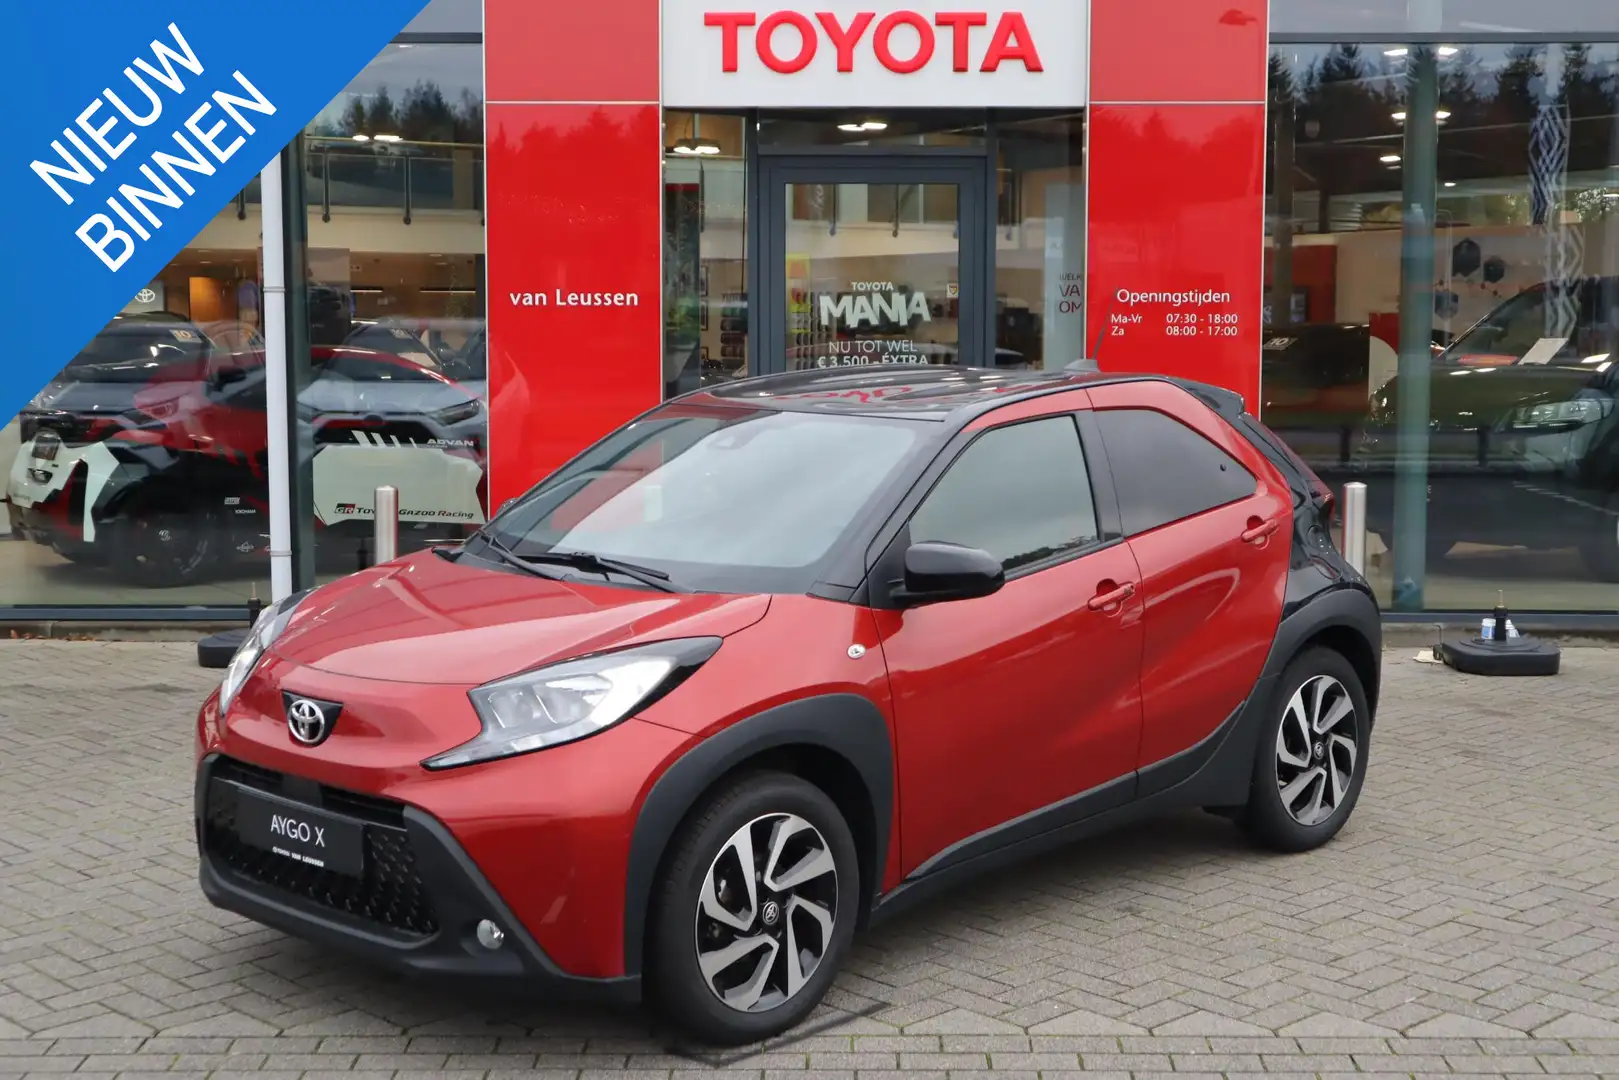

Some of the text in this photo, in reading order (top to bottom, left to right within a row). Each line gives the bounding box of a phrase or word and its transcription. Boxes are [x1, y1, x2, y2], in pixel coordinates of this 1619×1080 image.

[704, 10, 1044, 74] TOYOTA
[852, 282, 894, 291] TOYOTA
[509, 288, 639, 306] van Leussen
[1117, 289, 1230, 306] Openingstijden
[820, 291, 932, 329] MANIA
[1111, 314, 1142, 323] Ma-Vr
[1166, 313, 1197, 323] 07:30
[1208, 313, 1238, 323] 18:00
[1111, 326, 1125, 336] Za
[1166, 325, 1197, 336] 08:00
[1208, 326, 1238, 336] 17:00
[829, 340, 918, 353] NU TOT WEL
[817, 355, 826, 368] €
[438, 510, 474, 519] Racing
[271, 814, 325, 847] AYGO X
